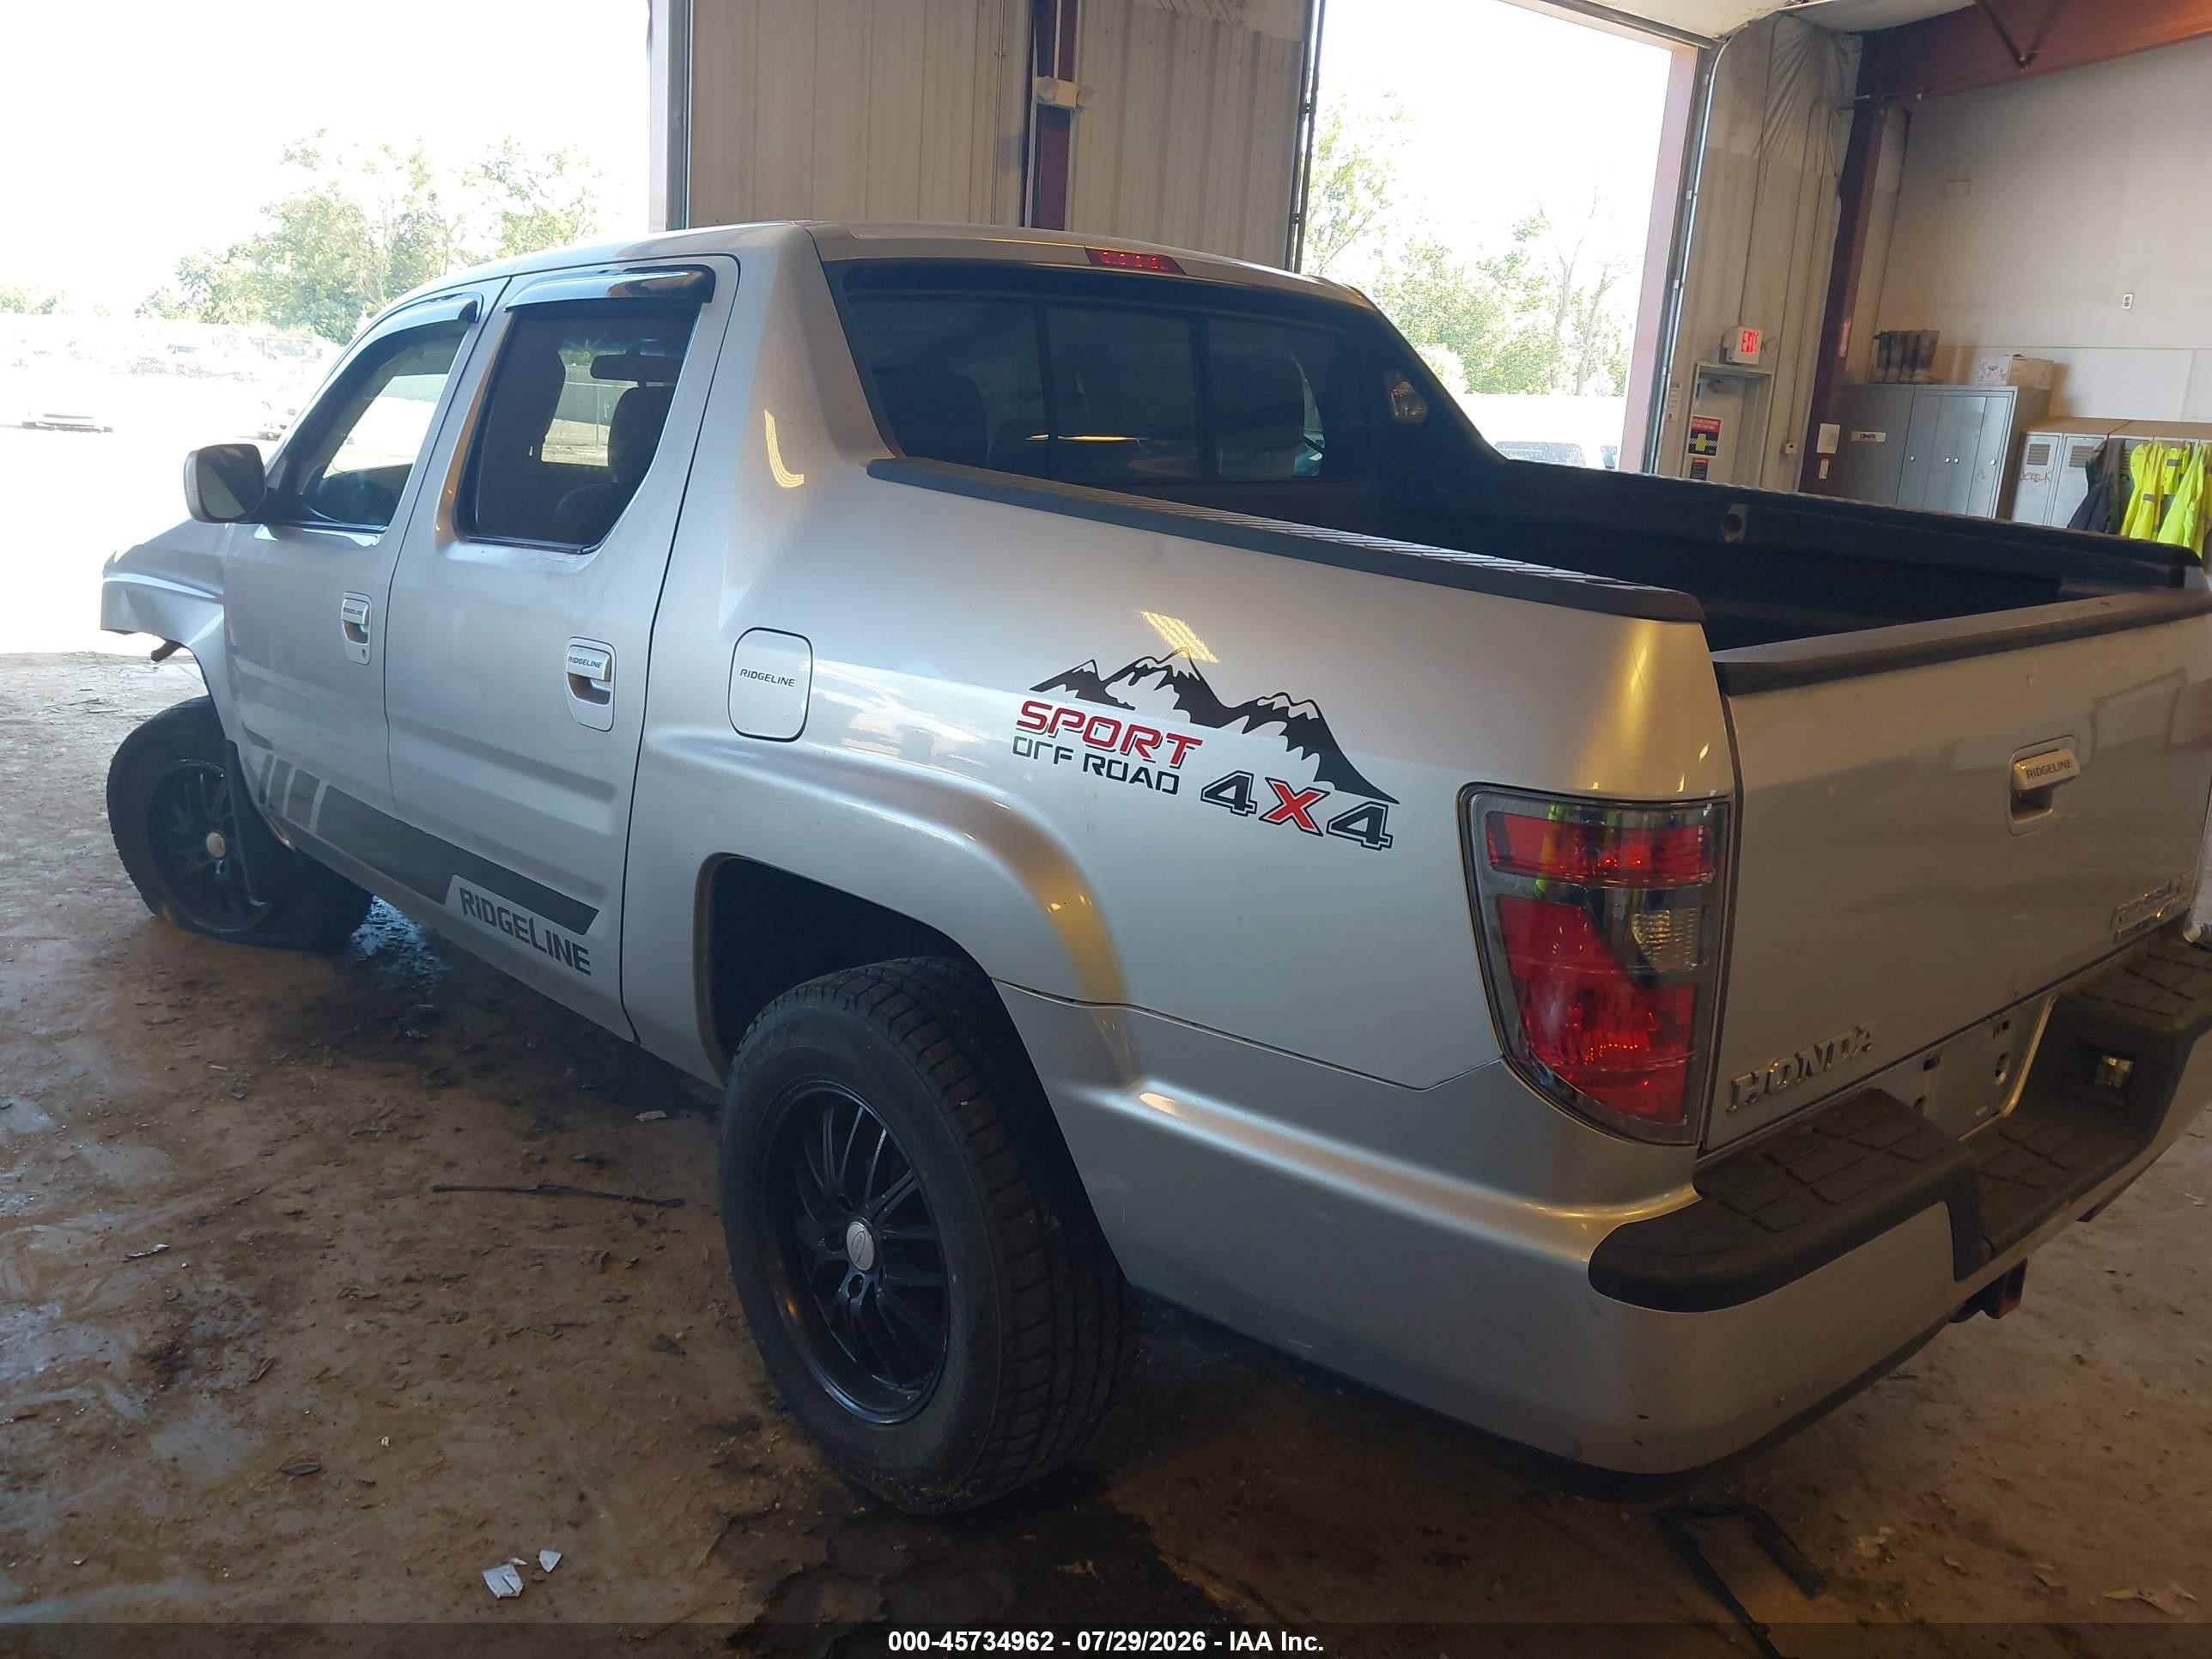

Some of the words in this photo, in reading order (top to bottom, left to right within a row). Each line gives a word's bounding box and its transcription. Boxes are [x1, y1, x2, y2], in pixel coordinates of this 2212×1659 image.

[1741, 330, 1759, 353] EXIT
[568, 656, 603, 668] RIDGELINE
[739, 668, 796, 687] RIDGELINE
[1012, 735, 1073, 766] OFF
[1083, 752, 1181, 795] ROAD
[1016, 700, 1203, 770] SPORT
[2026, 758, 2074, 780] RIDGELINE
[1200, 769, 1395, 851] 4X4
[459, 886, 592, 976] RIDGELINE
[1725, 1021, 1874, 1113] HONDA
